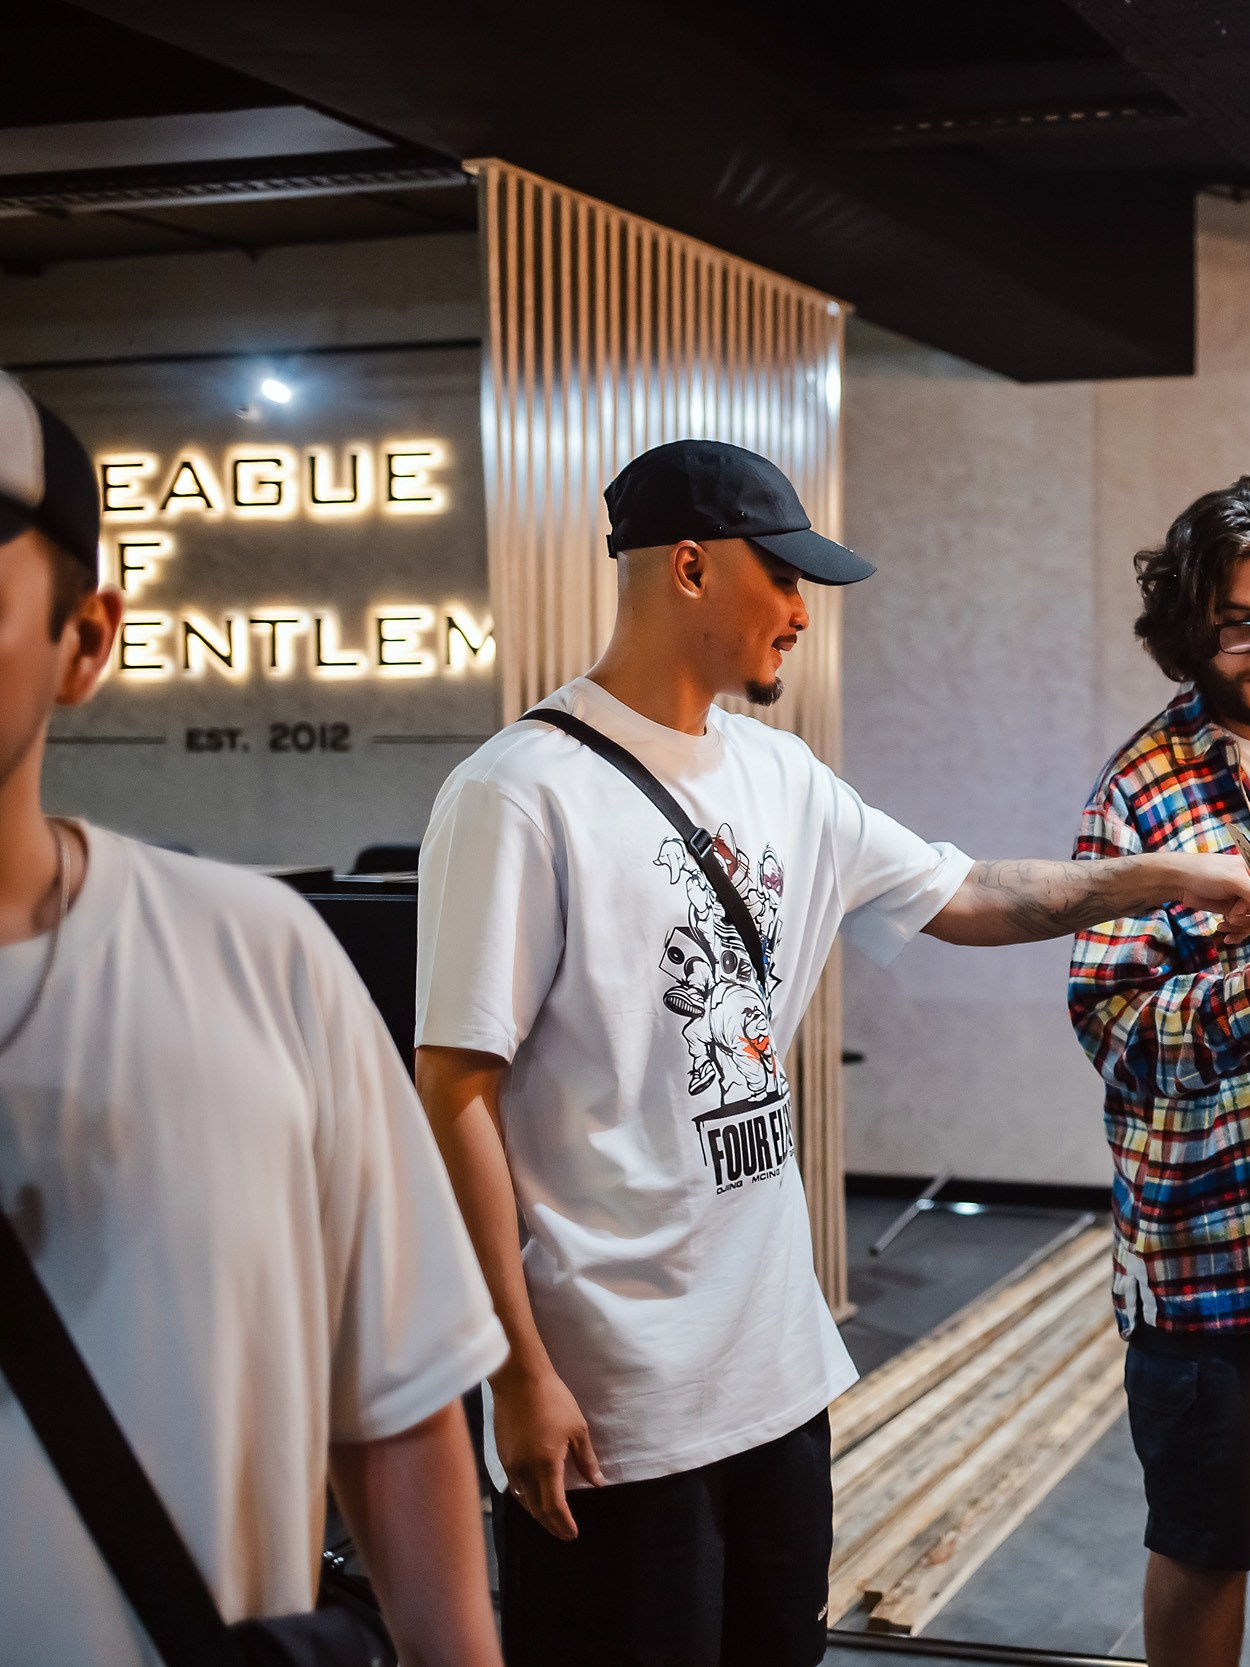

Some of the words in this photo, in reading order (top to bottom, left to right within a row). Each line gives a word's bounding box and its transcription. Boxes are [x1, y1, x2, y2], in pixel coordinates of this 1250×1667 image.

[98, 448, 436, 515] EAGUE
[115, 539, 165, 593] F
[117, 613, 497, 674] ENTLEM
[185, 726, 250, 753] EST.
[268, 721, 352, 753] 2012
[707, 1115, 773, 1187] FOUR
